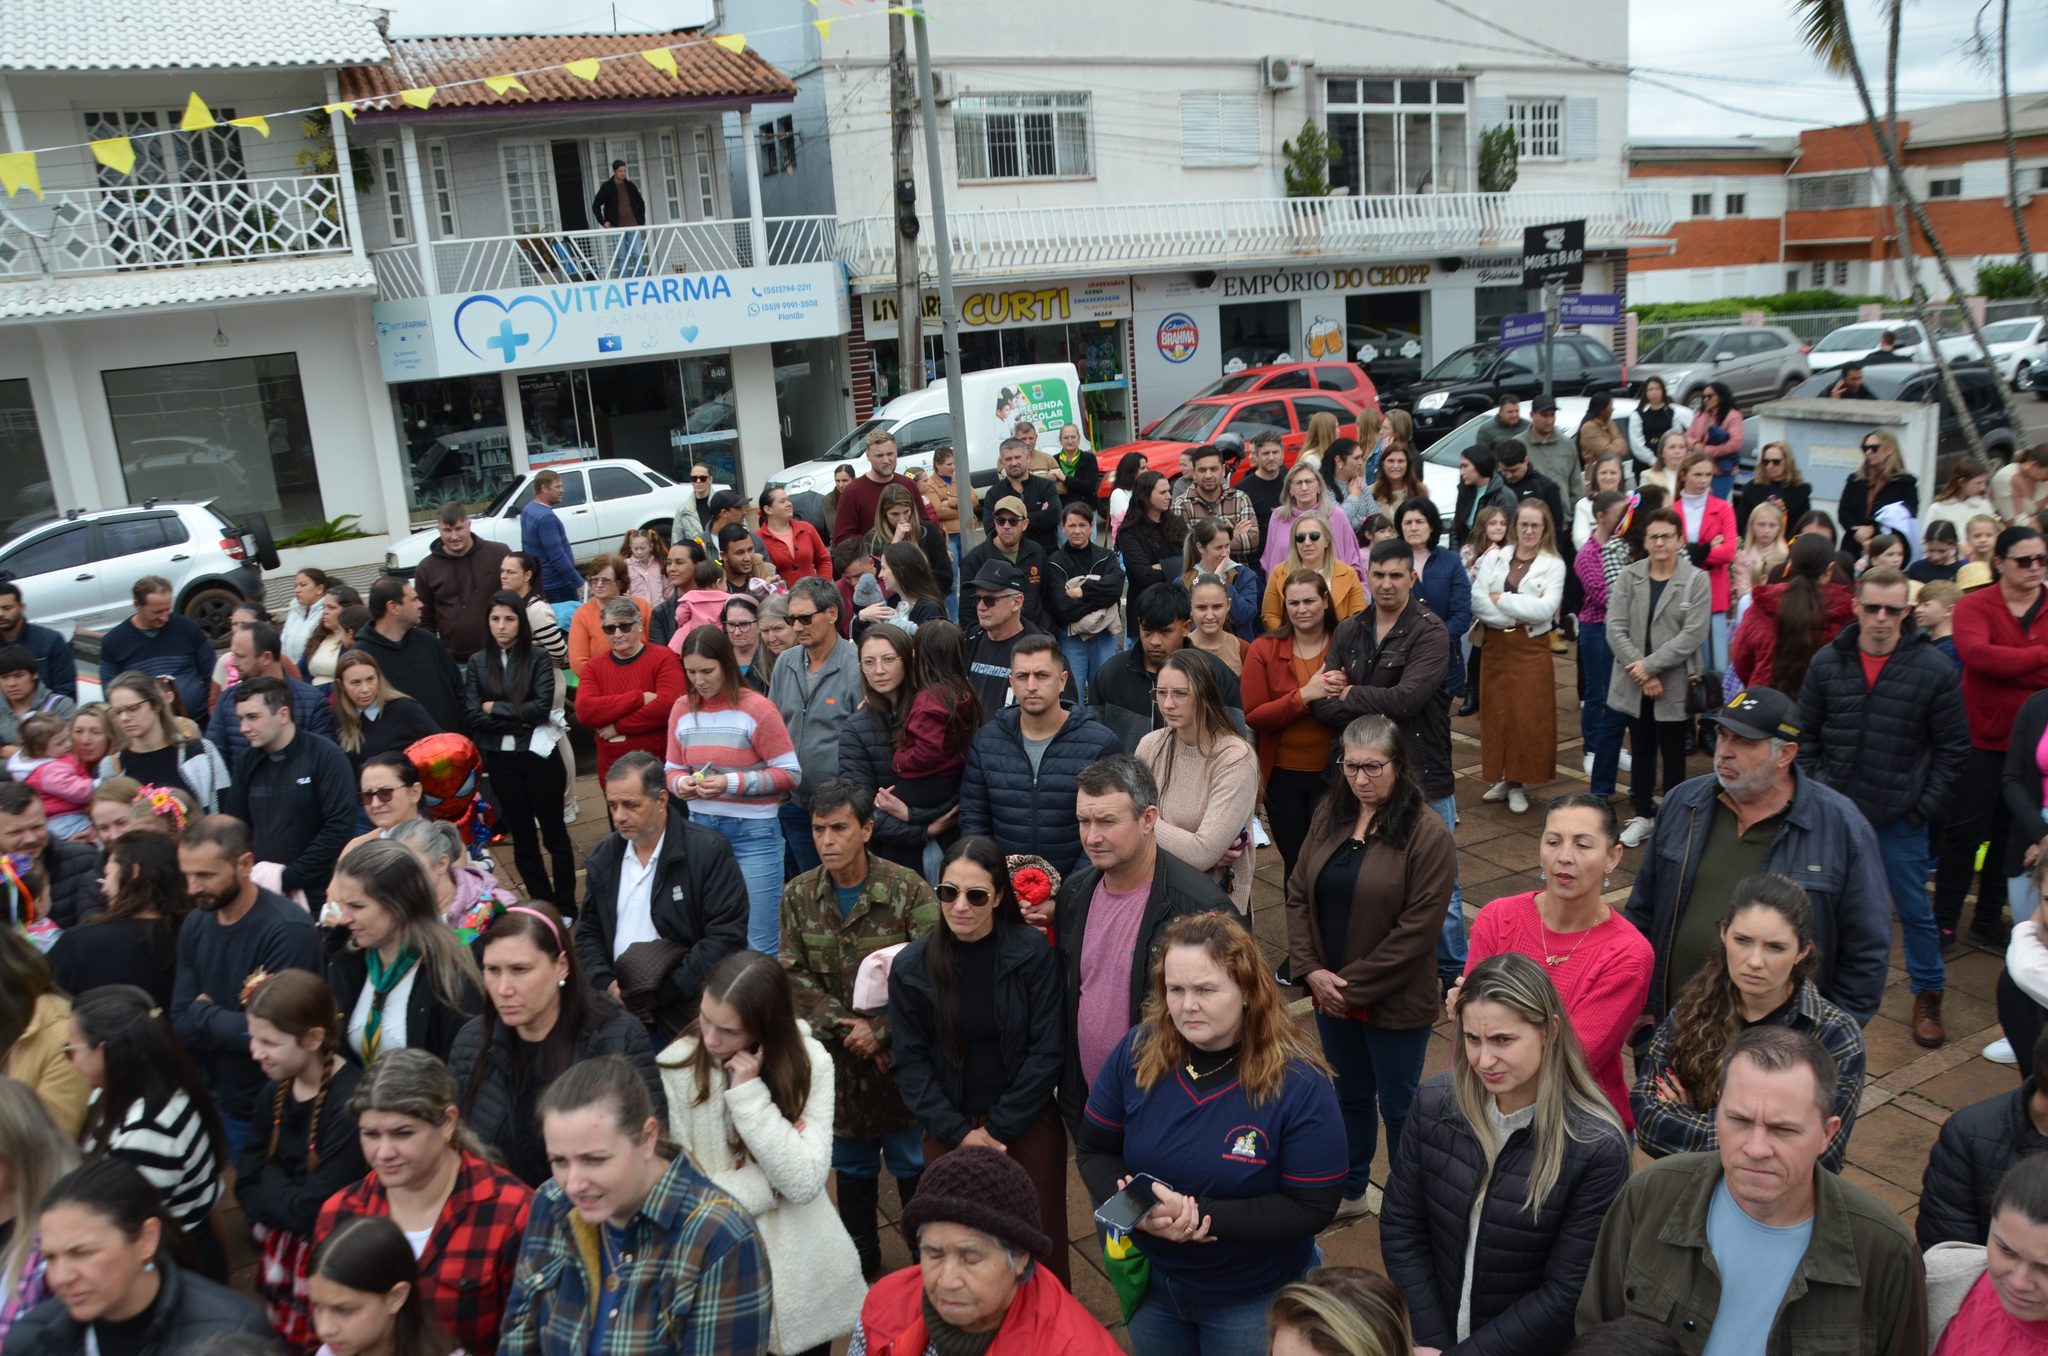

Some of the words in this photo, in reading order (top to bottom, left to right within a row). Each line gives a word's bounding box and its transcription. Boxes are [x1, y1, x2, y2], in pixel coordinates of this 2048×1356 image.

[1558, 248, 1583, 266] BAR
[1223, 267, 1330, 297] EMPÓRIO
[1333, 267, 1364, 290] DO
[1366, 263, 1430, 287] CHOPP
[551, 274, 732, 314] VITAFARMA
[962, 287, 1070, 327] CURTI
[778, 312, 805, 321] Plantão
[1161, 329, 1195, 346] BRAHMA
[1020, 400, 1064, 414] MERENDA
[1021, 410, 1063, 423] ESCOLAR
